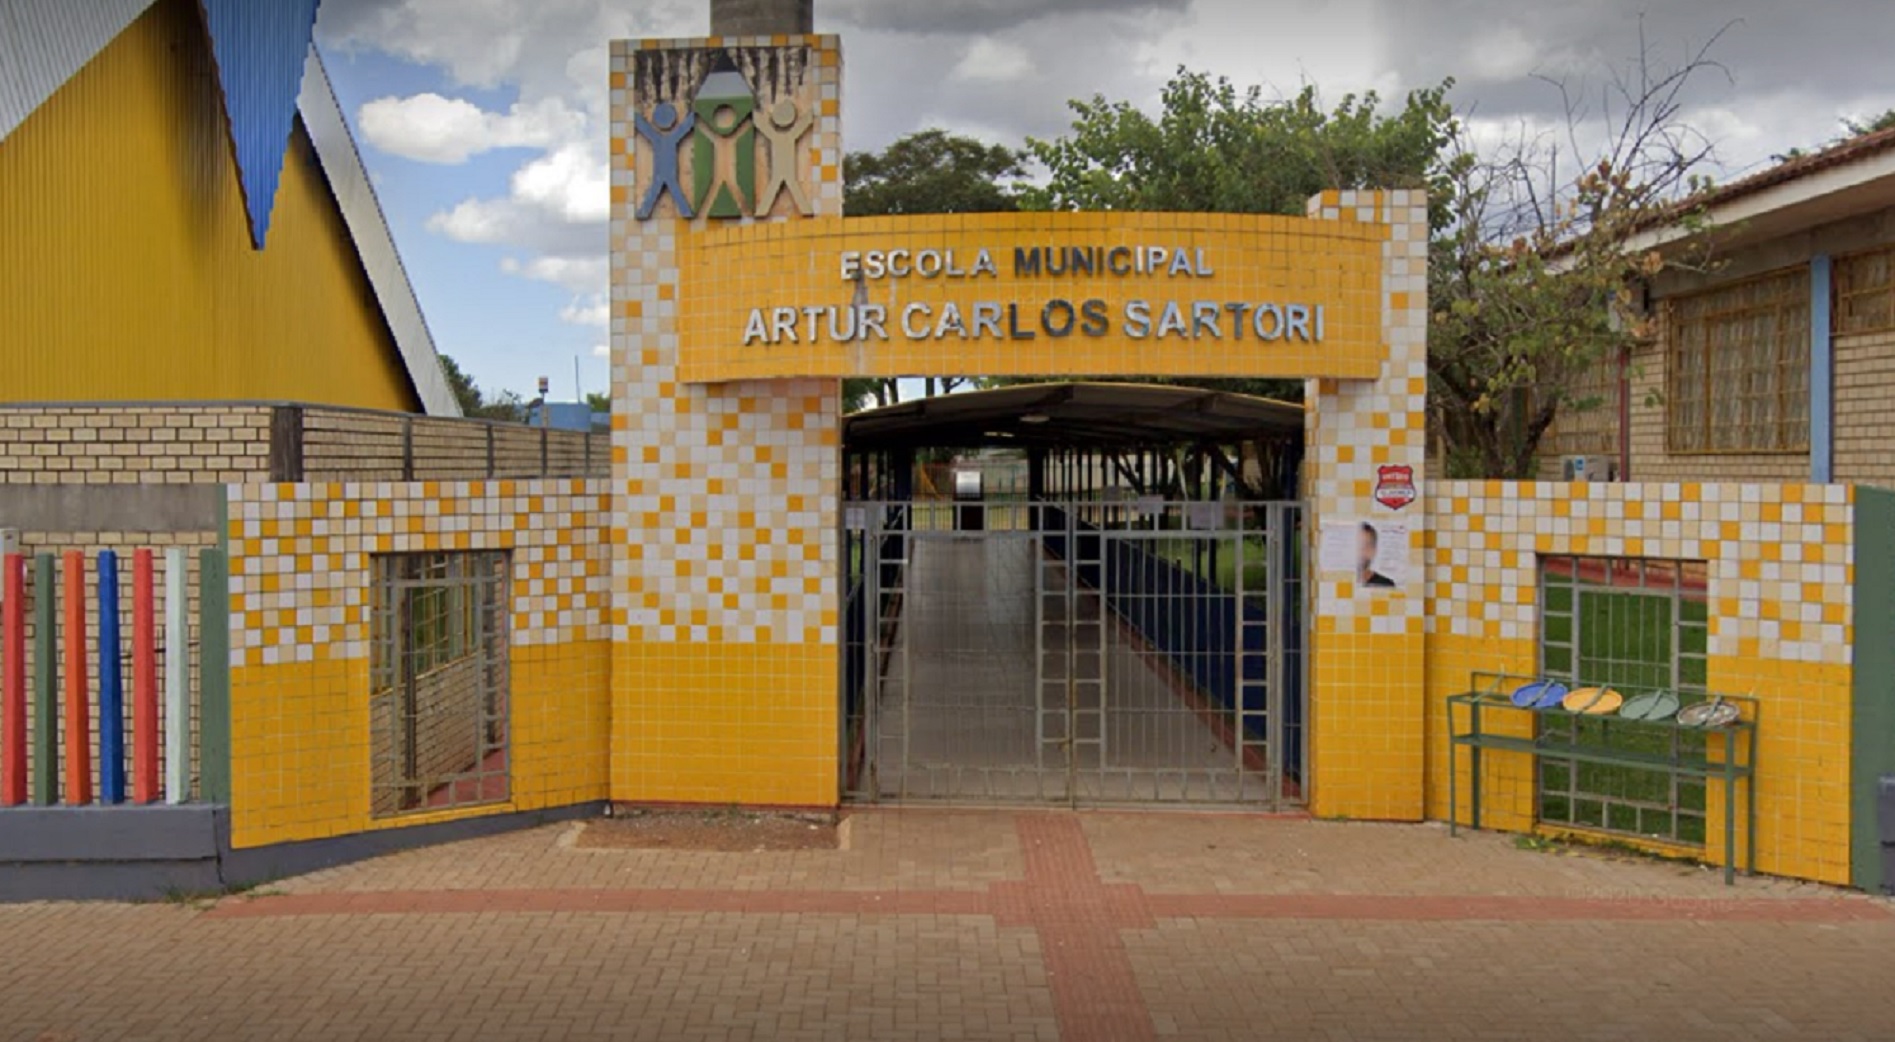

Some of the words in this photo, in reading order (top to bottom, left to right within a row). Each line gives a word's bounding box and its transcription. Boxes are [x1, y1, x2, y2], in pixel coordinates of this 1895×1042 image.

[841, 248, 997, 280] ESCOLA
[1014, 246, 1214, 277] MUNICIPAL
[744, 302, 888, 345] ARTUR
[902, 299, 1110, 339] CARLOS
[1123, 300, 1324, 342] SARTORI
